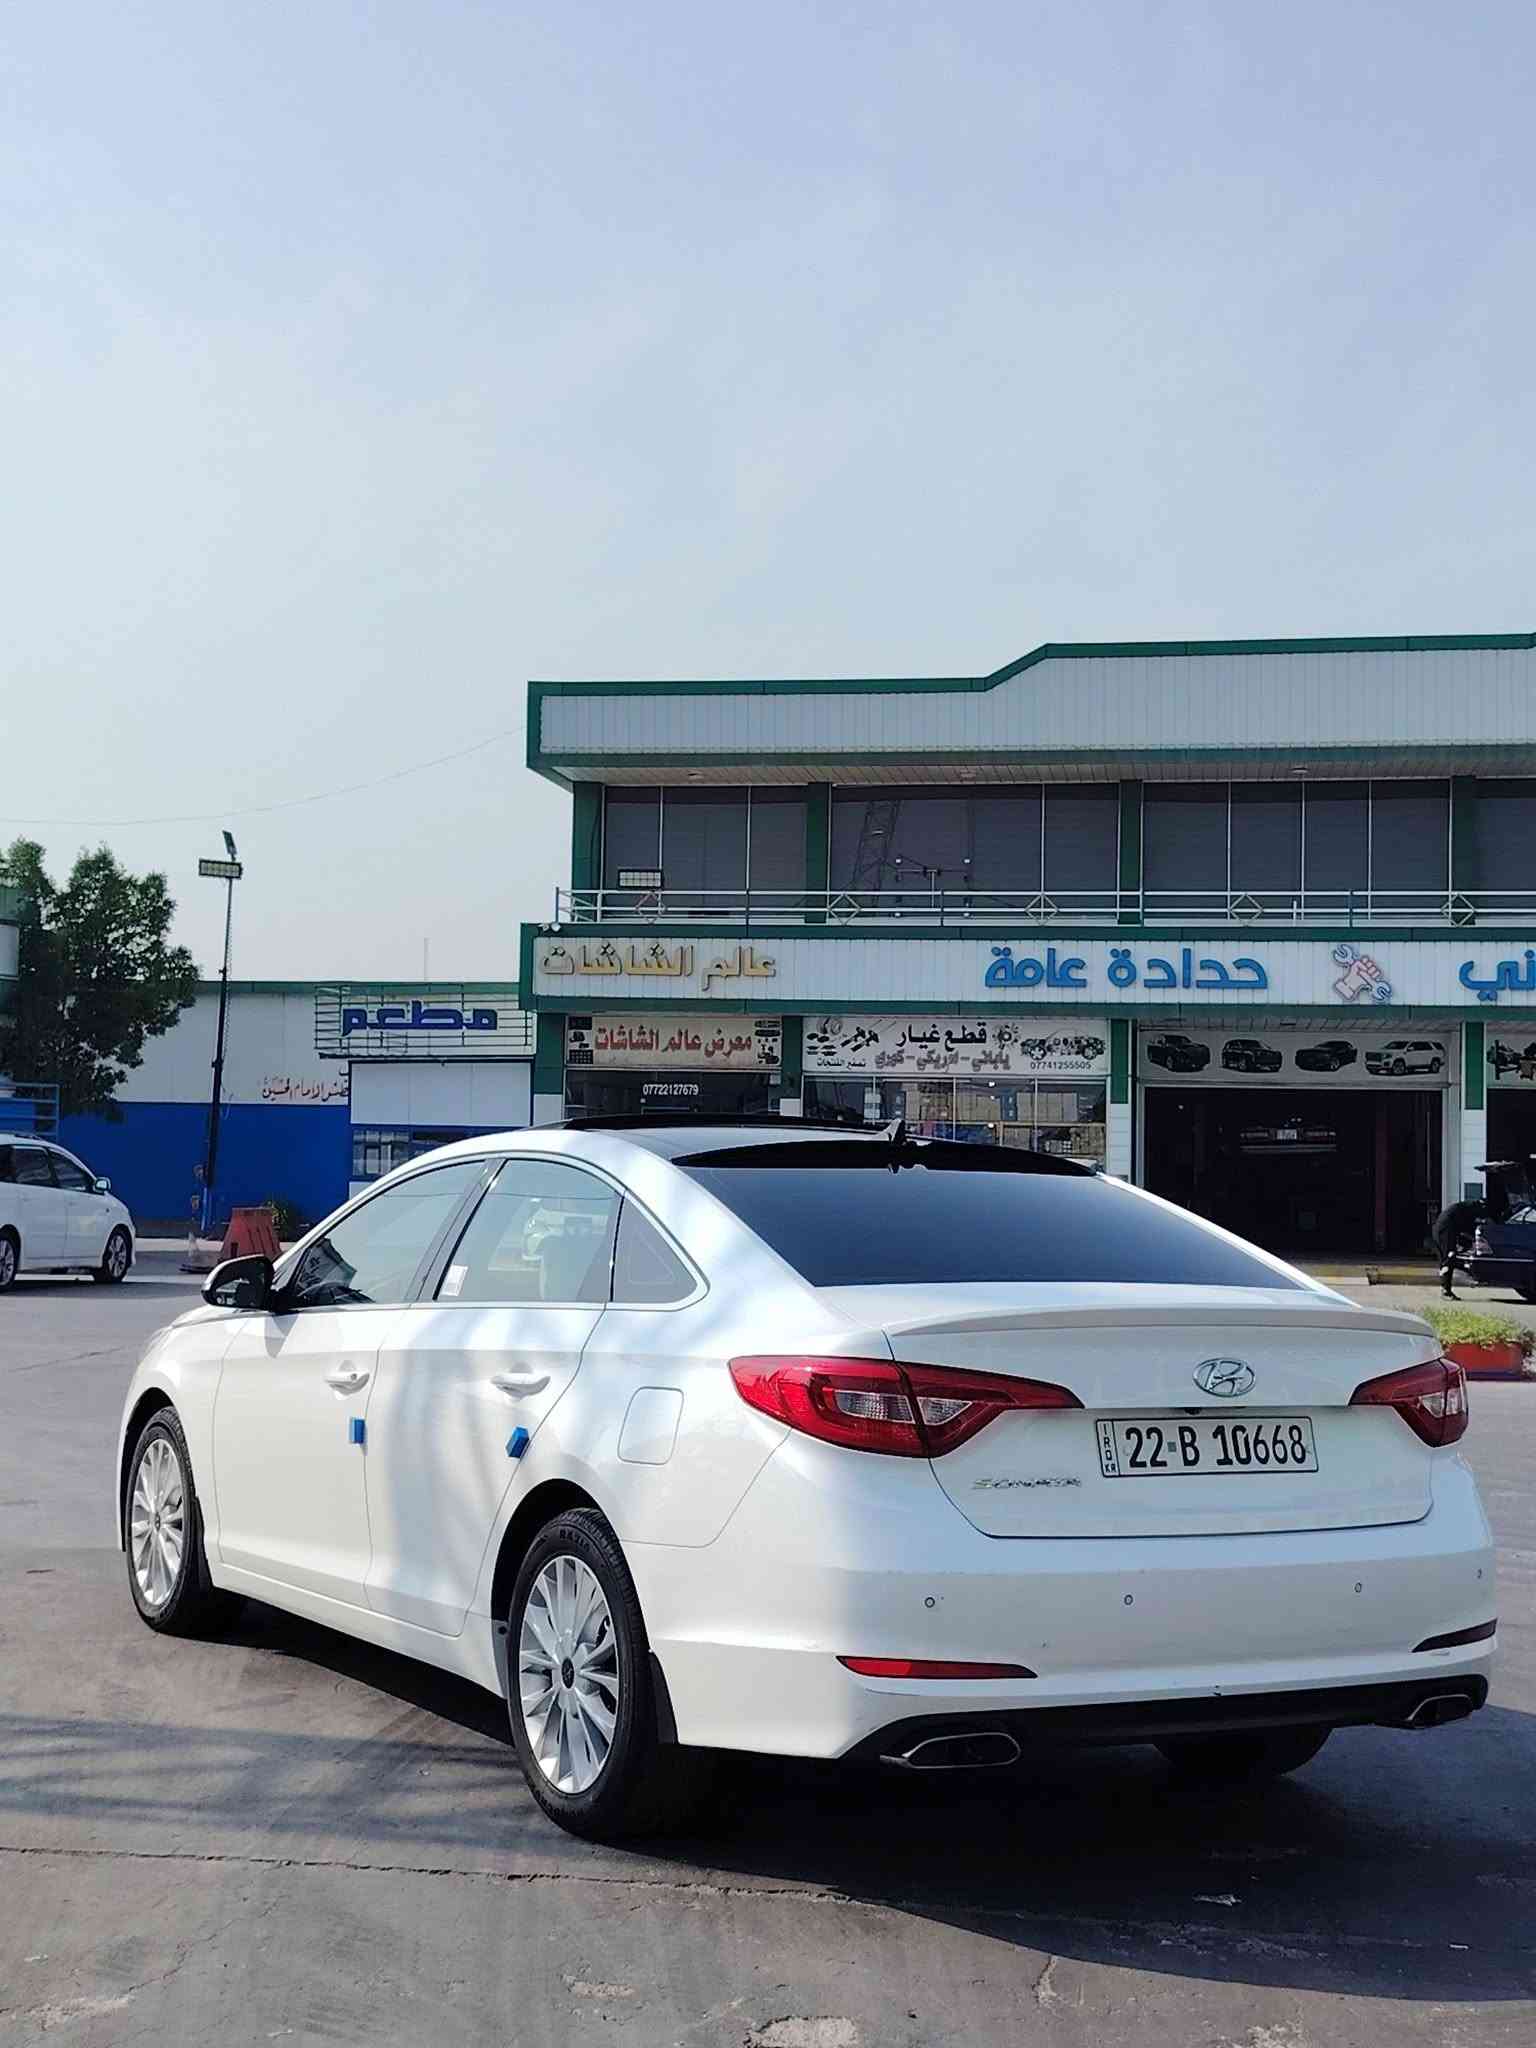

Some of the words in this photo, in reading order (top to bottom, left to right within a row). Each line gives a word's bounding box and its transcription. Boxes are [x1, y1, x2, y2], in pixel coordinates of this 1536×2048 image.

[541, 943, 694, 976] الشاشات
[701, 945, 776, 991] عالم
[984, 946, 1087, 988] عامة
[1107, 948, 1268, 989] حدادة
[342, 1000, 497, 1037] مطعم
[594, 1024, 660, 1051] الشاشات
[661, 1028, 702, 1052] عالم
[704, 1028, 752, 1058] معرض
[896, 1023, 940, 1049] غيار
[944, 1021, 987, 1052] قطع
[642, 1083, 699, 1096] 07722127679
[1125, 1426, 1168, 1468] 22
[1178, 1425, 1200, 1467] B
[1212, 1424, 1307, 1466] 10668
